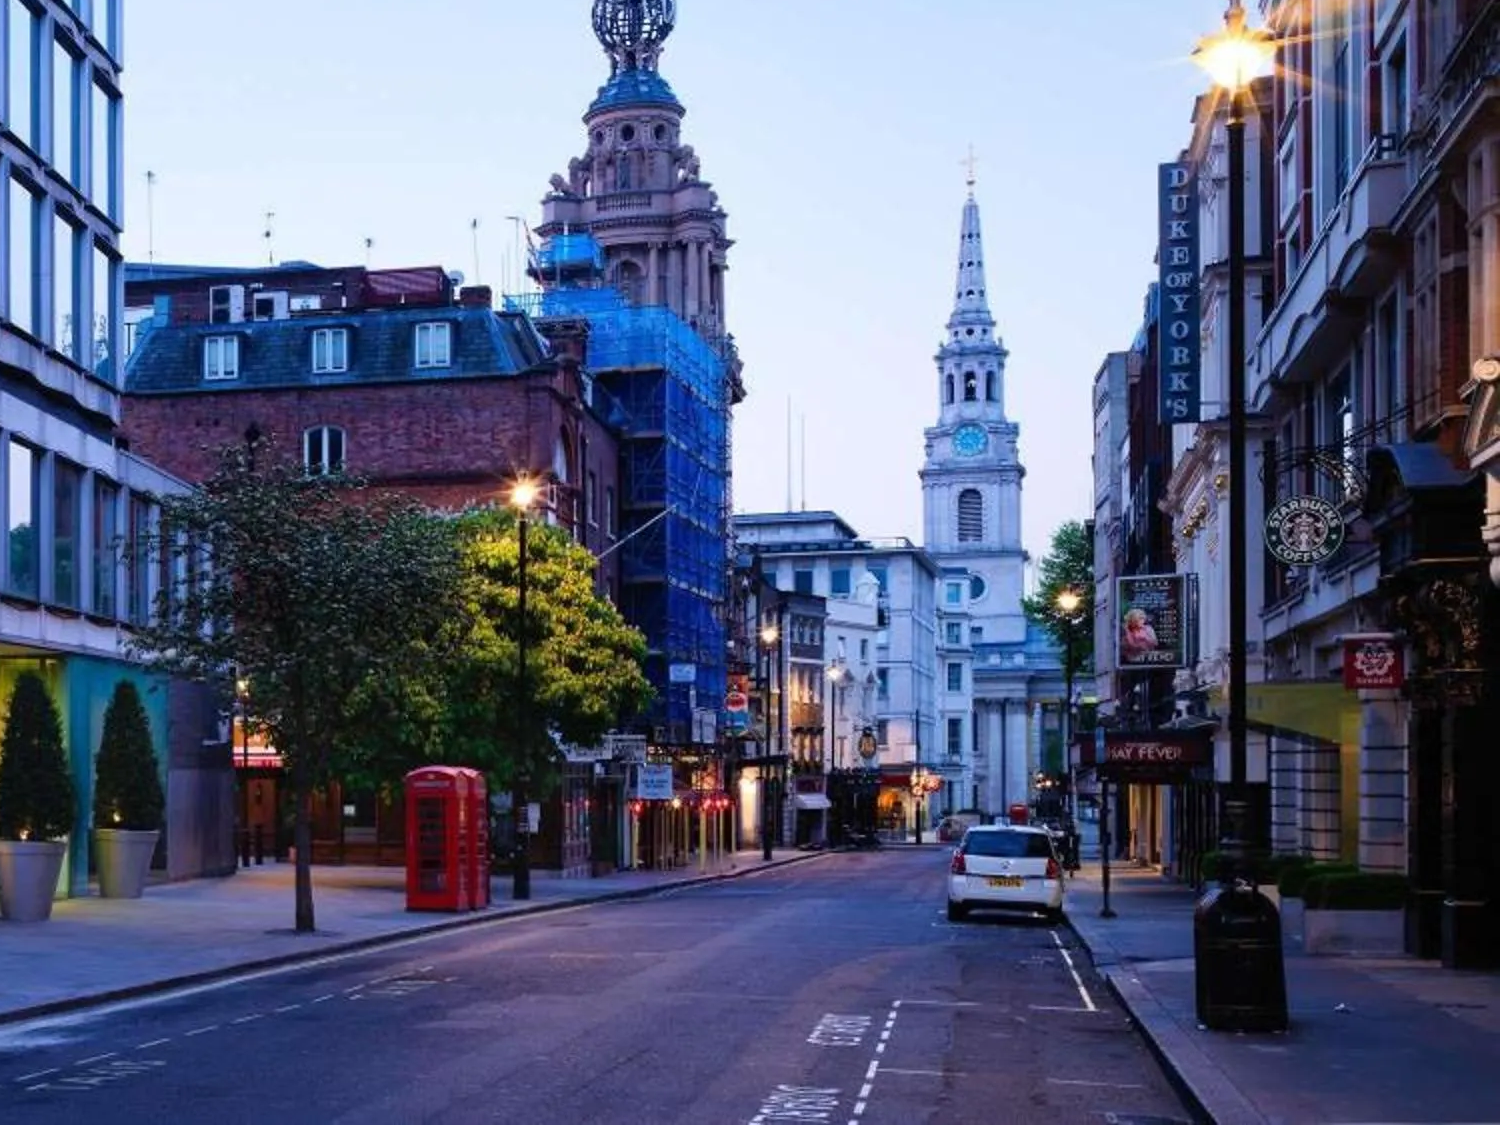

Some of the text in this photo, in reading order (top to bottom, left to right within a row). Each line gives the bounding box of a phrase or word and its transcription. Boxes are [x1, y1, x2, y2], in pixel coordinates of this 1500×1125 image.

[1168, 168, 1190, 265] DUKE
[1166, 272, 1192, 288] OF
[1269, 500, 1341, 528] STARBUCKS
[1275, 544, 1329, 562] COFFEE
[1138, 746, 1183, 759] FEVER
